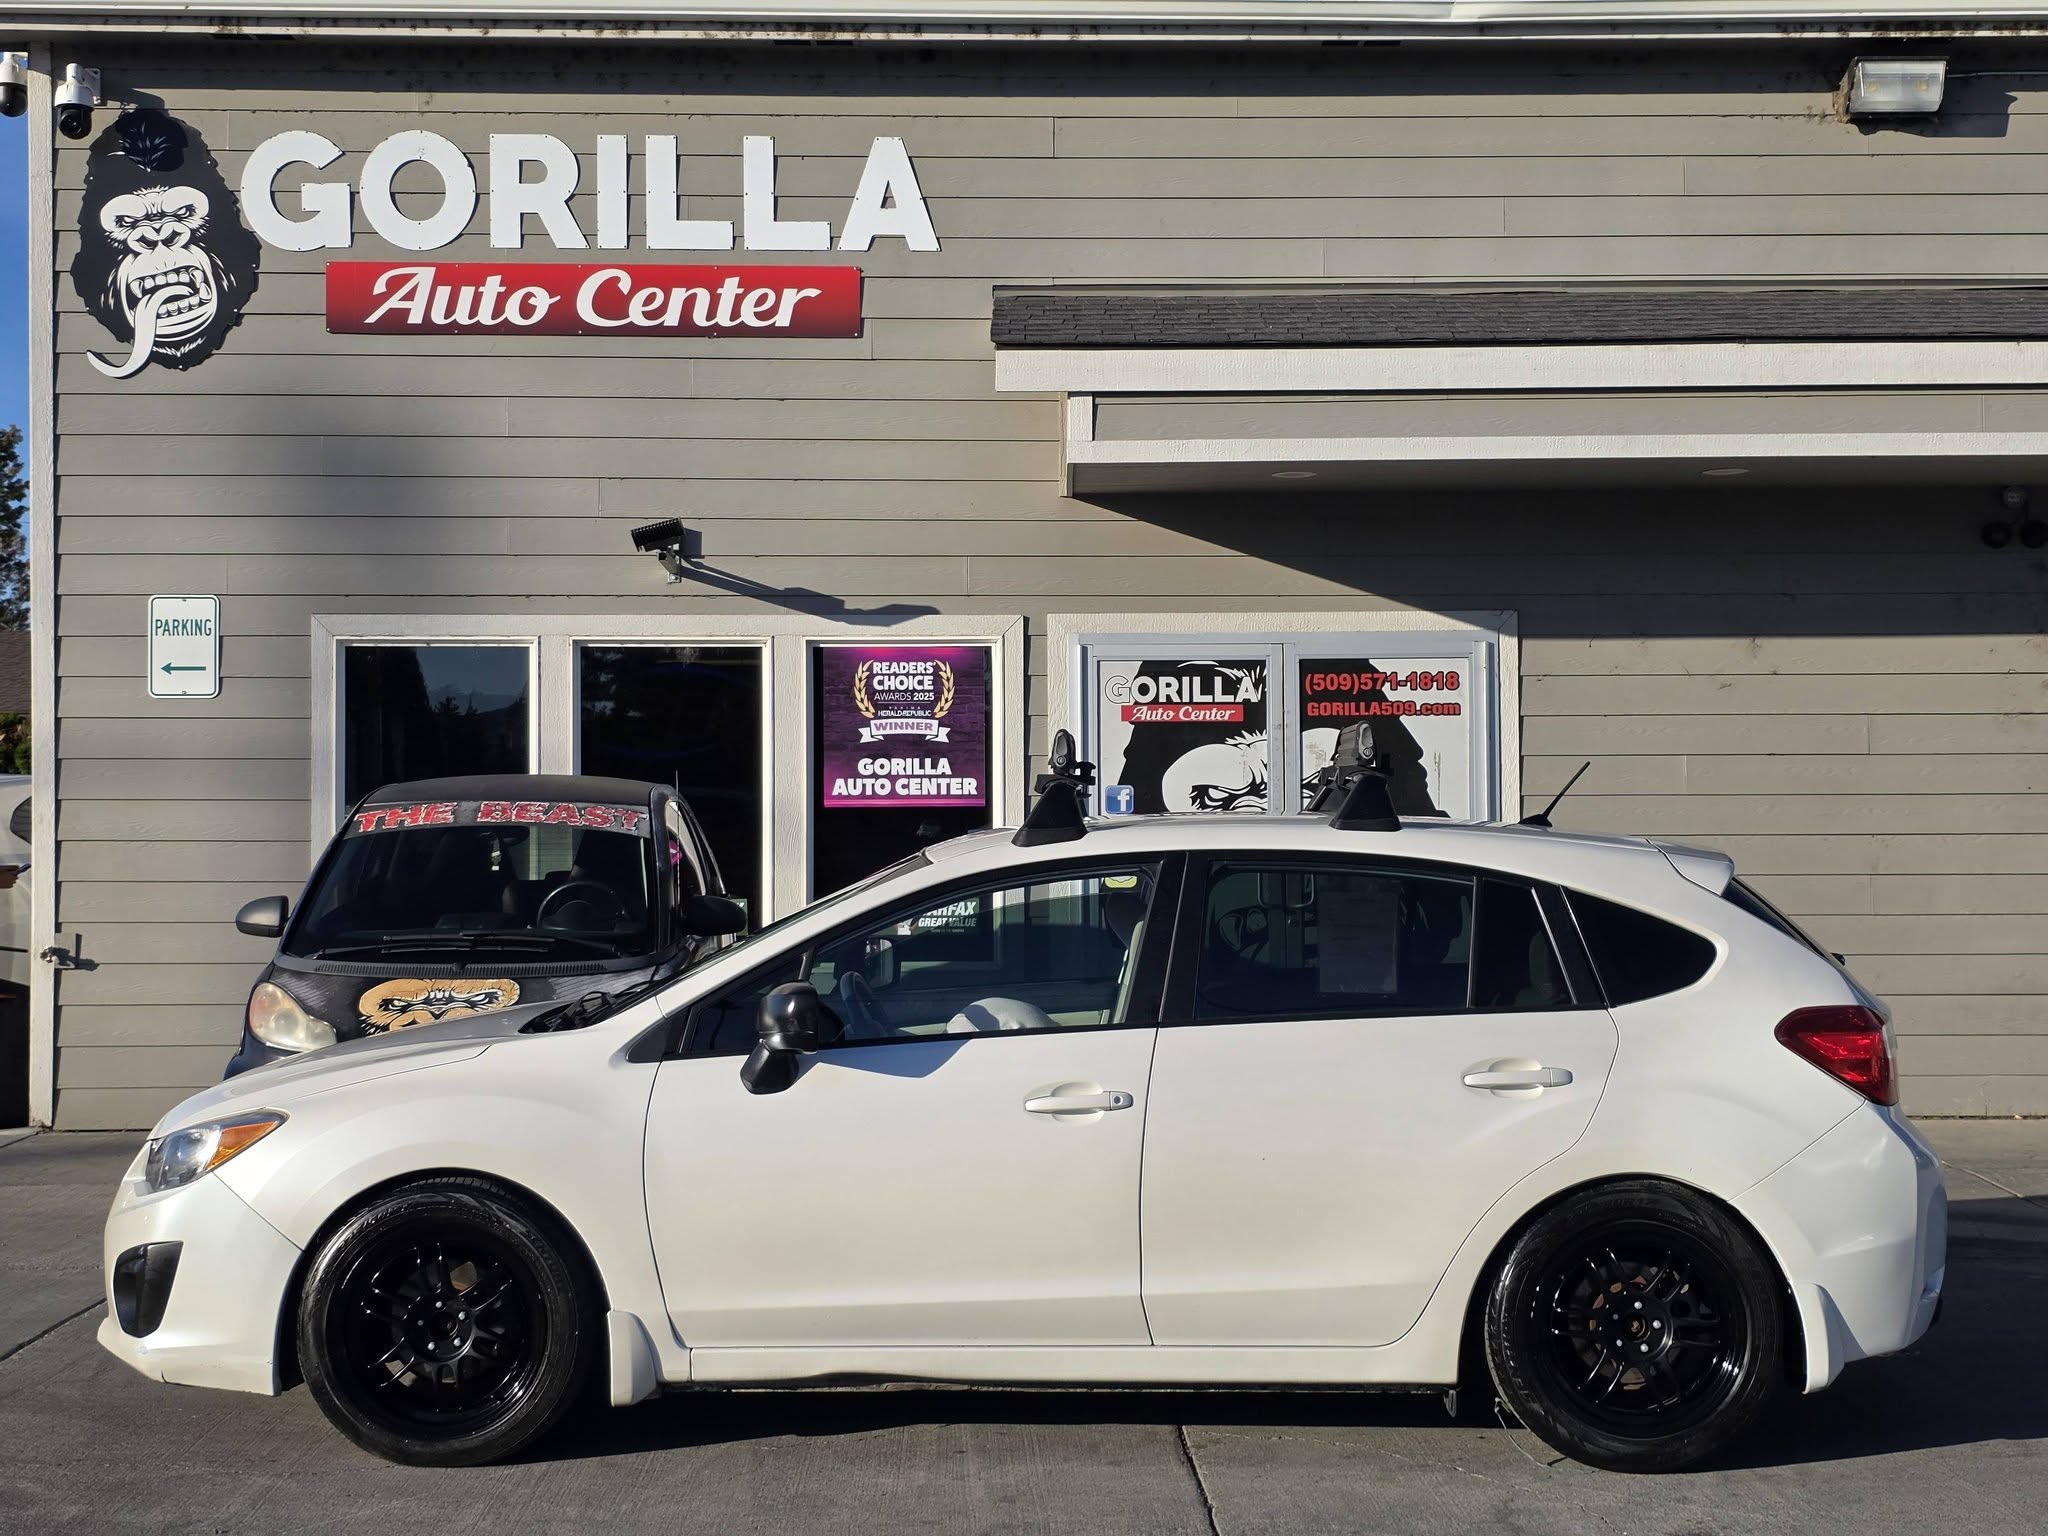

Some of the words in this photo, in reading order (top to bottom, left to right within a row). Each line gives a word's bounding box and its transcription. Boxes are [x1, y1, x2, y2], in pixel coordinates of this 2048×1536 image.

[240, 129, 942, 252] GORILLA
[364, 266, 561, 327] Auto
[575, 263, 821, 329] Center
[154, 618, 212, 636] PARKING
[872, 661, 936, 674] READERS'
[872, 675, 934, 690] CHOICE
[1104, 674, 1260, 704] GORILLA
[1304, 671, 1460, 694] (509)571-1818
[873, 692, 912, 701] AWARDS
[913, 692, 935, 701] 2025
[1132, 705, 1176, 721] Auto
[1178, 705, 1236, 721] Center
[1306, 701, 1461, 717] GORILLA509.com
[873, 721, 934, 731] WINNER
[857, 758, 952, 775] GORILLA
[832, 778, 892, 796] AUTO
[895, 778, 978, 796] CENTER
[354, 801, 458, 833] THE
[478, 800, 649, 831] BEAST
[918, 917, 948, 927] GREAT
[949, 917, 977, 927] VALUE
